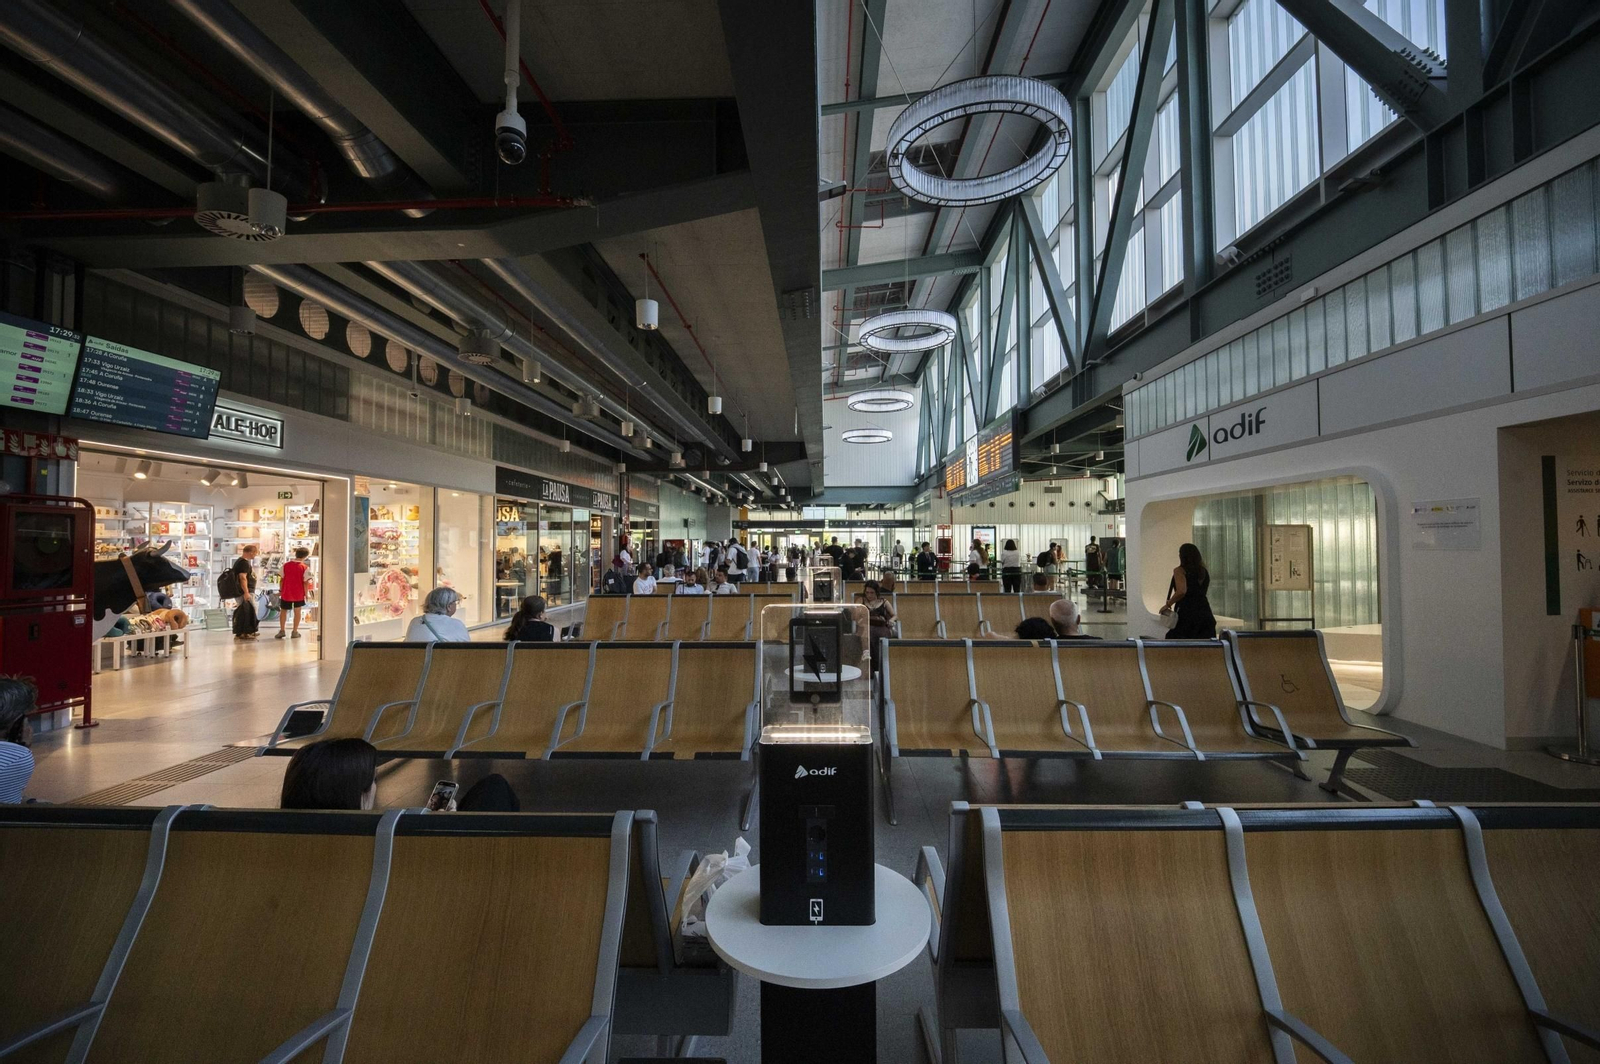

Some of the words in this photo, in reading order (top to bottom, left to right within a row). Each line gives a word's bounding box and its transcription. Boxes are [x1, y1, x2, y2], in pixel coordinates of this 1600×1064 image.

[106, 343, 129, 354] Saídas
[109, 353, 127, 361] Coruña
[114, 364, 130, 372] Urzaiz
[104, 373, 123, 381] Coruña
[97, 380, 119, 390] Ourense
[213, 414, 277, 439] ALE-HOP
[1213, 406, 1267, 444] adif
[549, 481, 570, 503] PAUSA
[598, 492, 612, 510] PAUSA
[809, 767, 837, 775] adif
